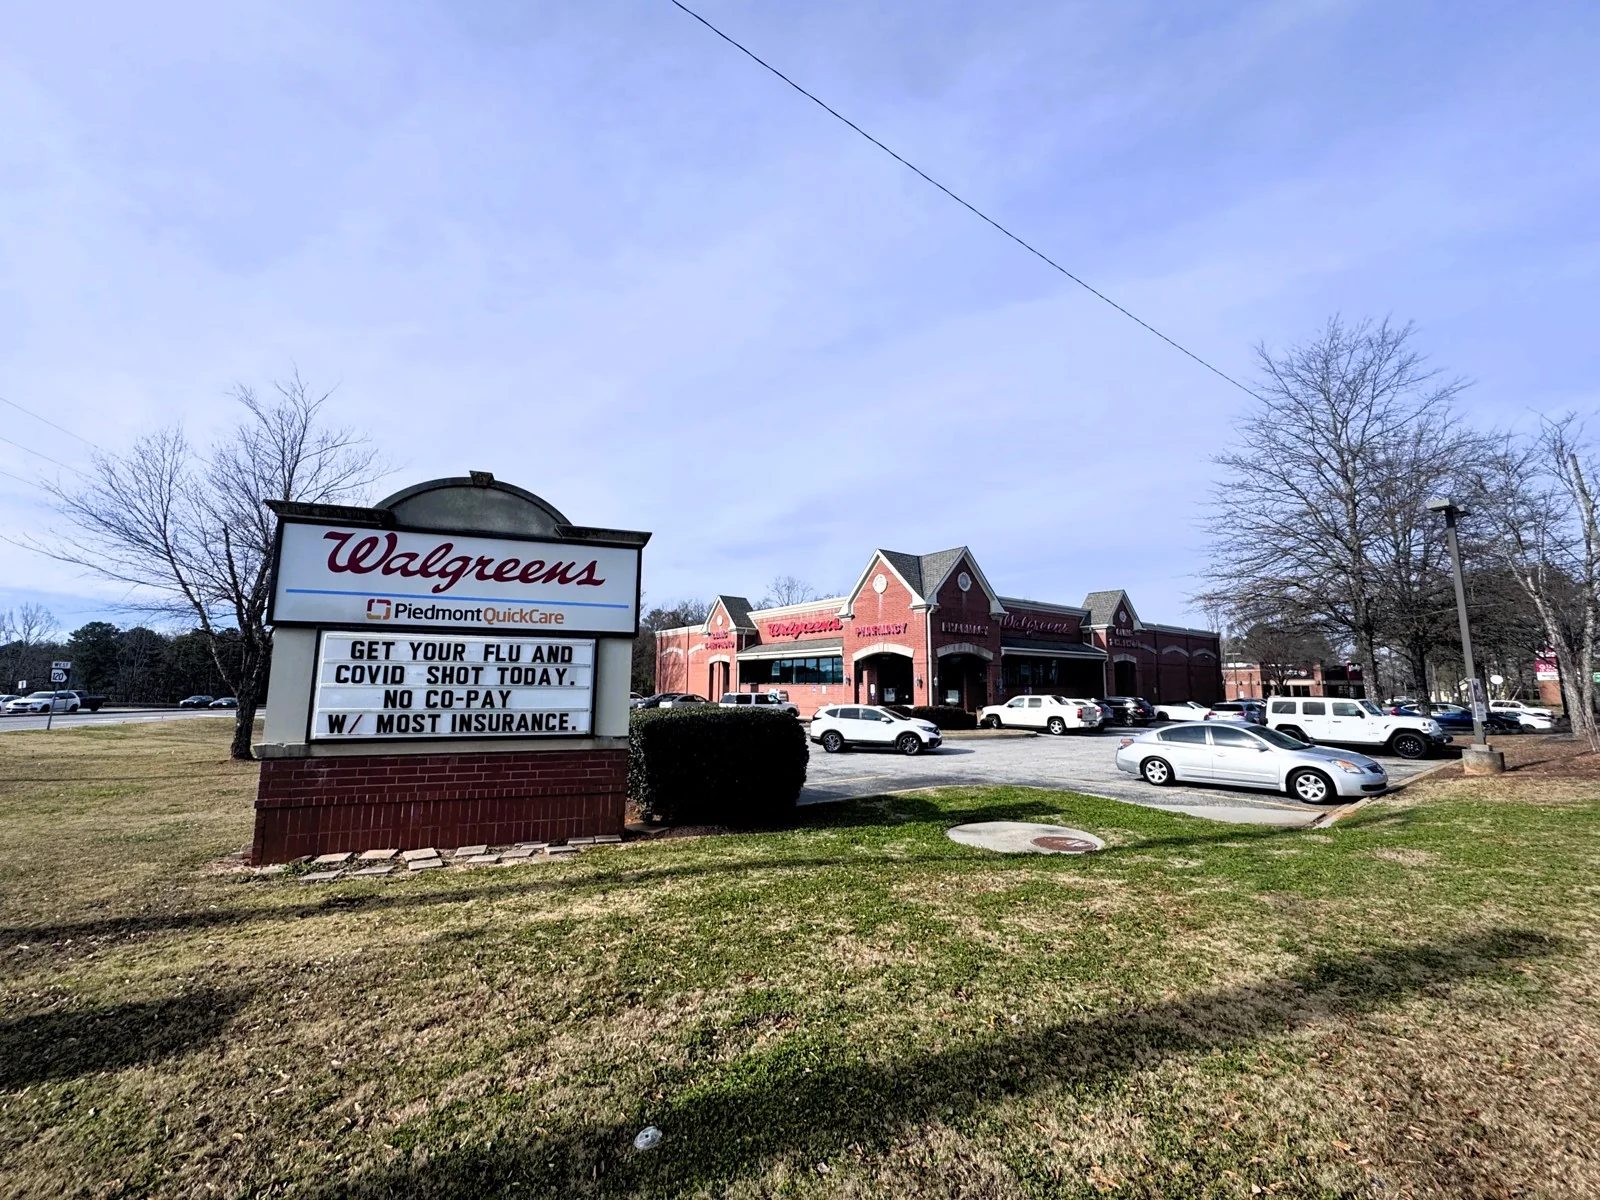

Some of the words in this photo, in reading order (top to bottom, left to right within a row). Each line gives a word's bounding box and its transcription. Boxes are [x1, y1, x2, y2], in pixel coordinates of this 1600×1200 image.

[323, 531, 606, 594] Walgreens
[767, 618, 843, 639] Walgreens
[855, 623, 907, 637] PHARMACY
[350, 641, 395, 660] GET
[409, 642, 466, 662] YOUR
[483, 643, 521, 663] FLU
[531, 645, 573, 664] AND
[53, 672, 64, 680] 120
[335, 665, 405, 684] COVID
[426, 666, 484, 685] SHOT
[496, 667, 575, 686] TODAY.
[383, 689, 413, 709] NO
[425, 690, 512, 709] CO-PAY
[328, 714, 363, 734] W/
[376, 713, 441, 733] MOST
[451, 713, 577, 733] INSURANCE.
